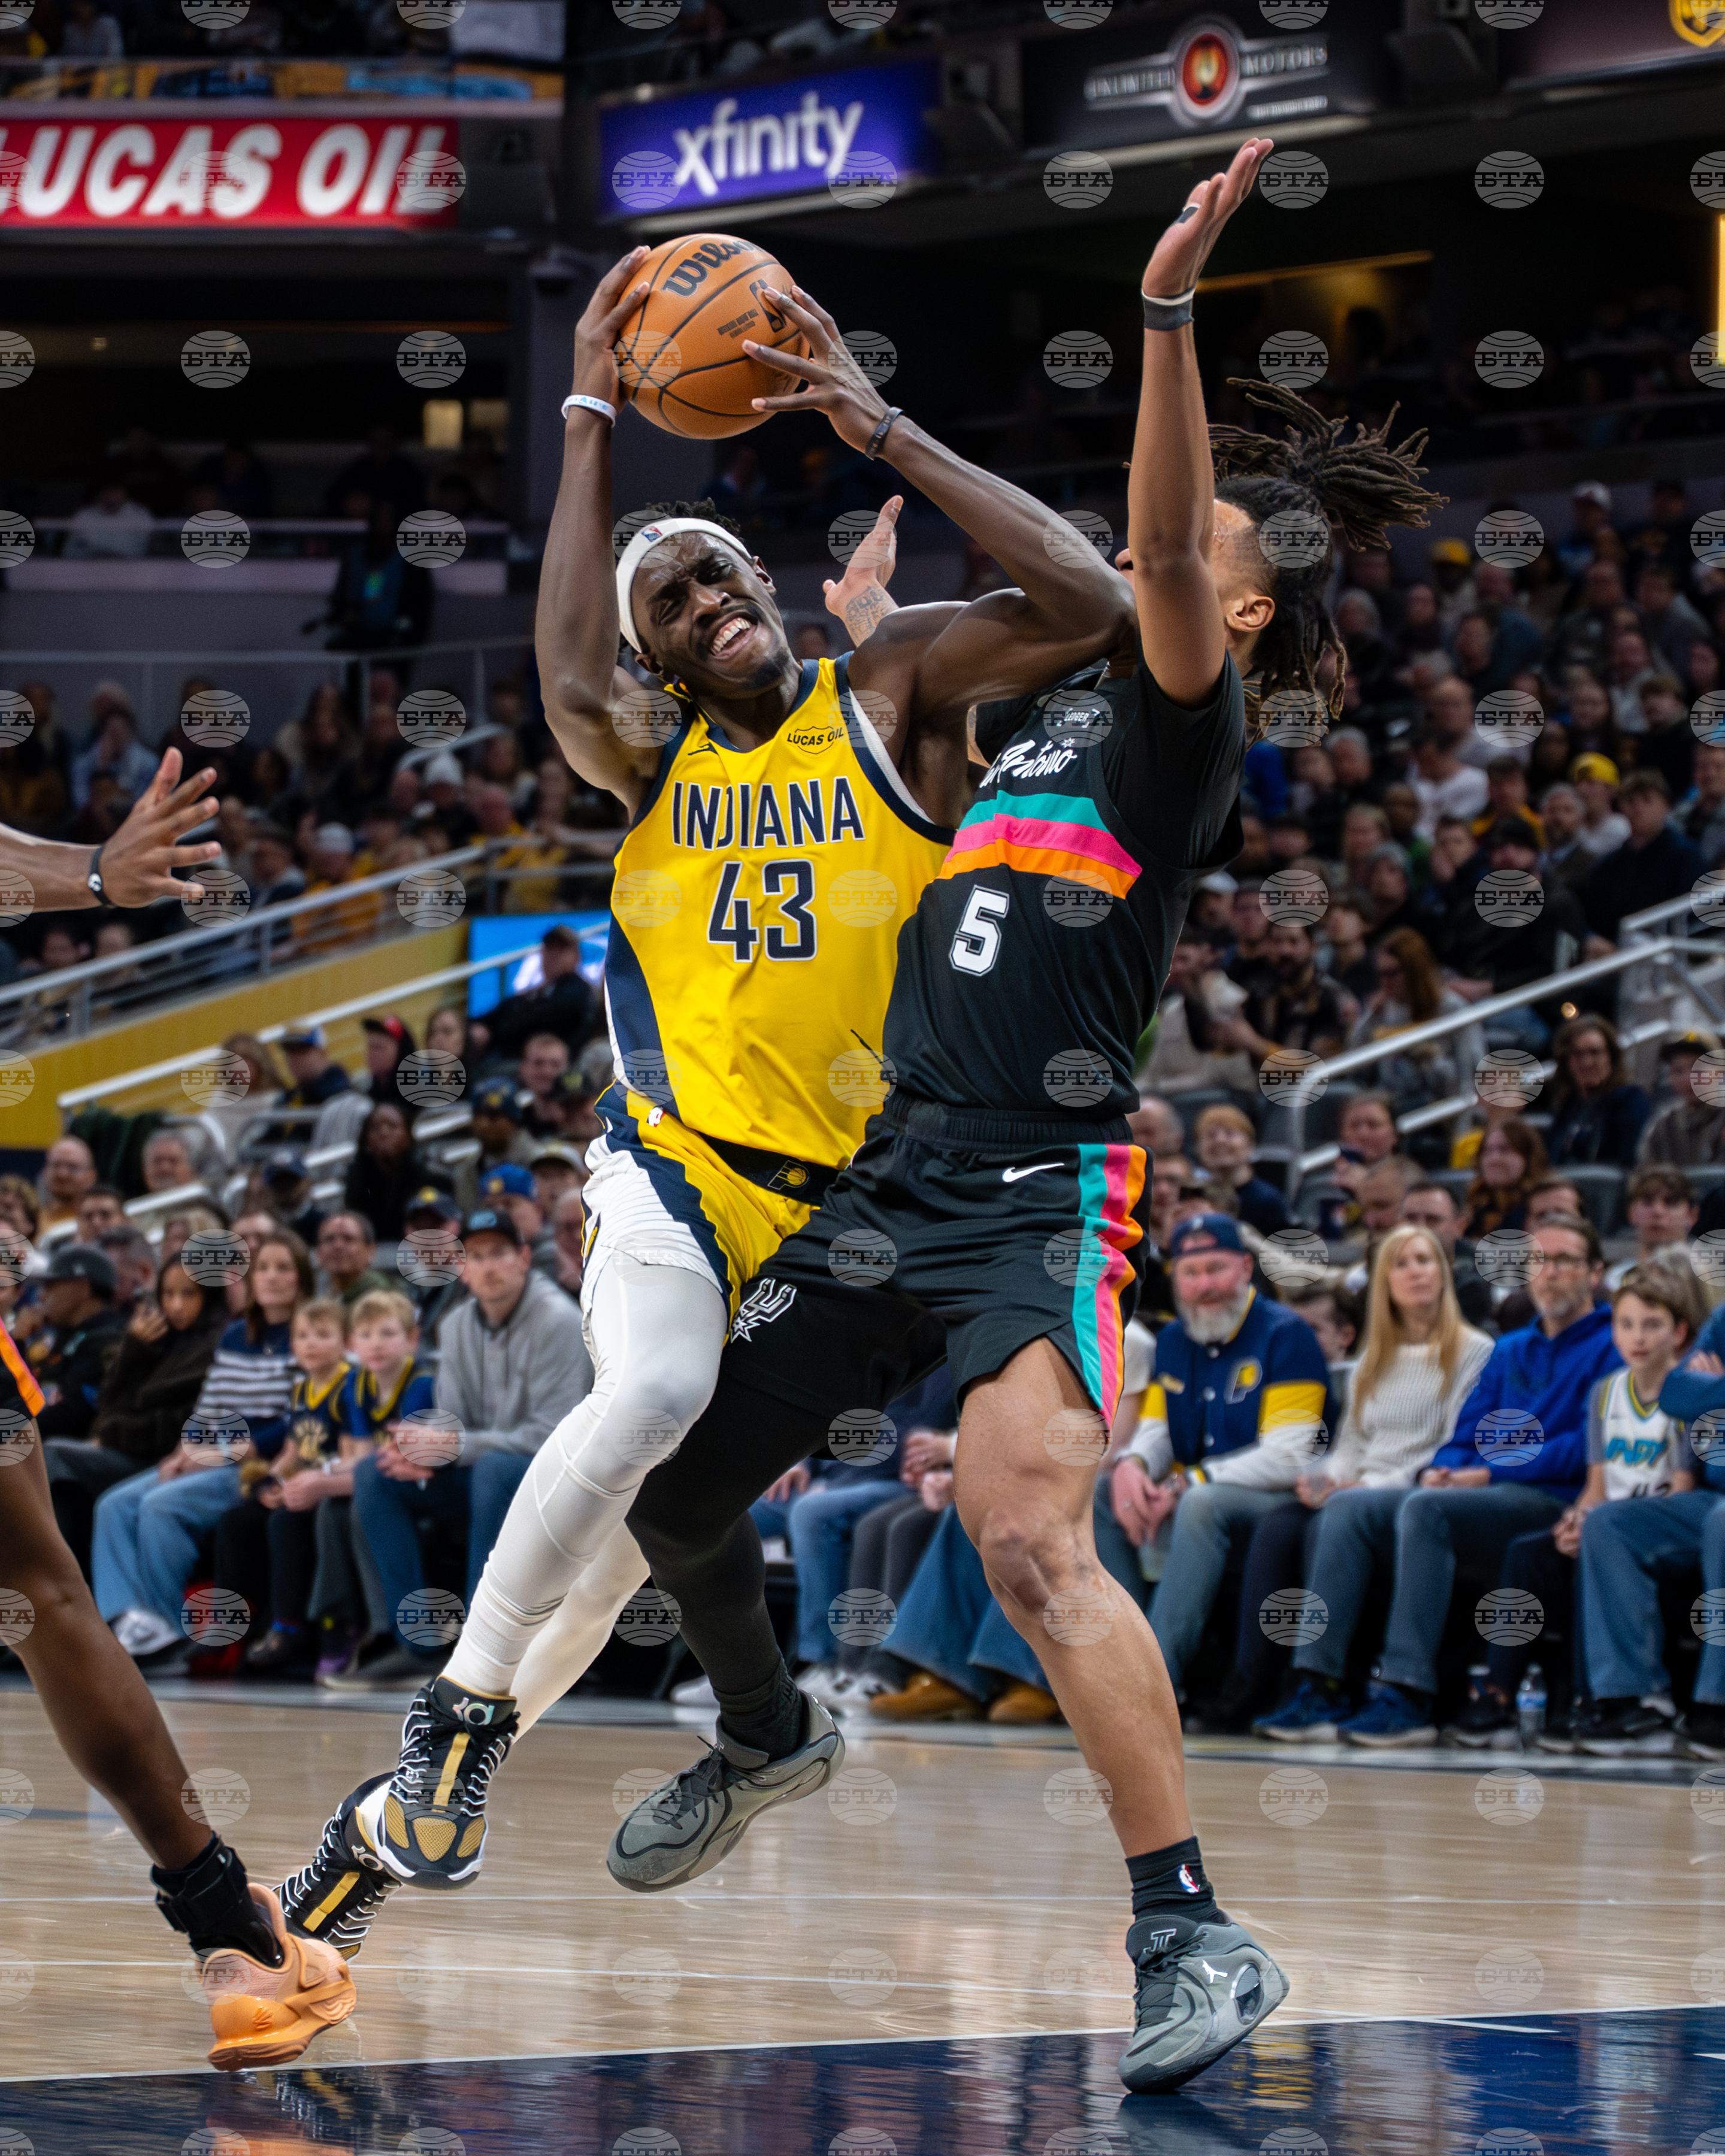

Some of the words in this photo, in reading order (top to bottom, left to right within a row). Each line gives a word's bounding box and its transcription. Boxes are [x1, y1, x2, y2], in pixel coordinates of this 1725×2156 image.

[296, 123, 447, 216] OIL
[673, 92, 864, 196] xfinity
[786, 732, 825, 746] LUCAS
[827, 727, 844, 742] OIL
[707, 858, 818, 963] 43
[949, 884, 1011, 977] 5
